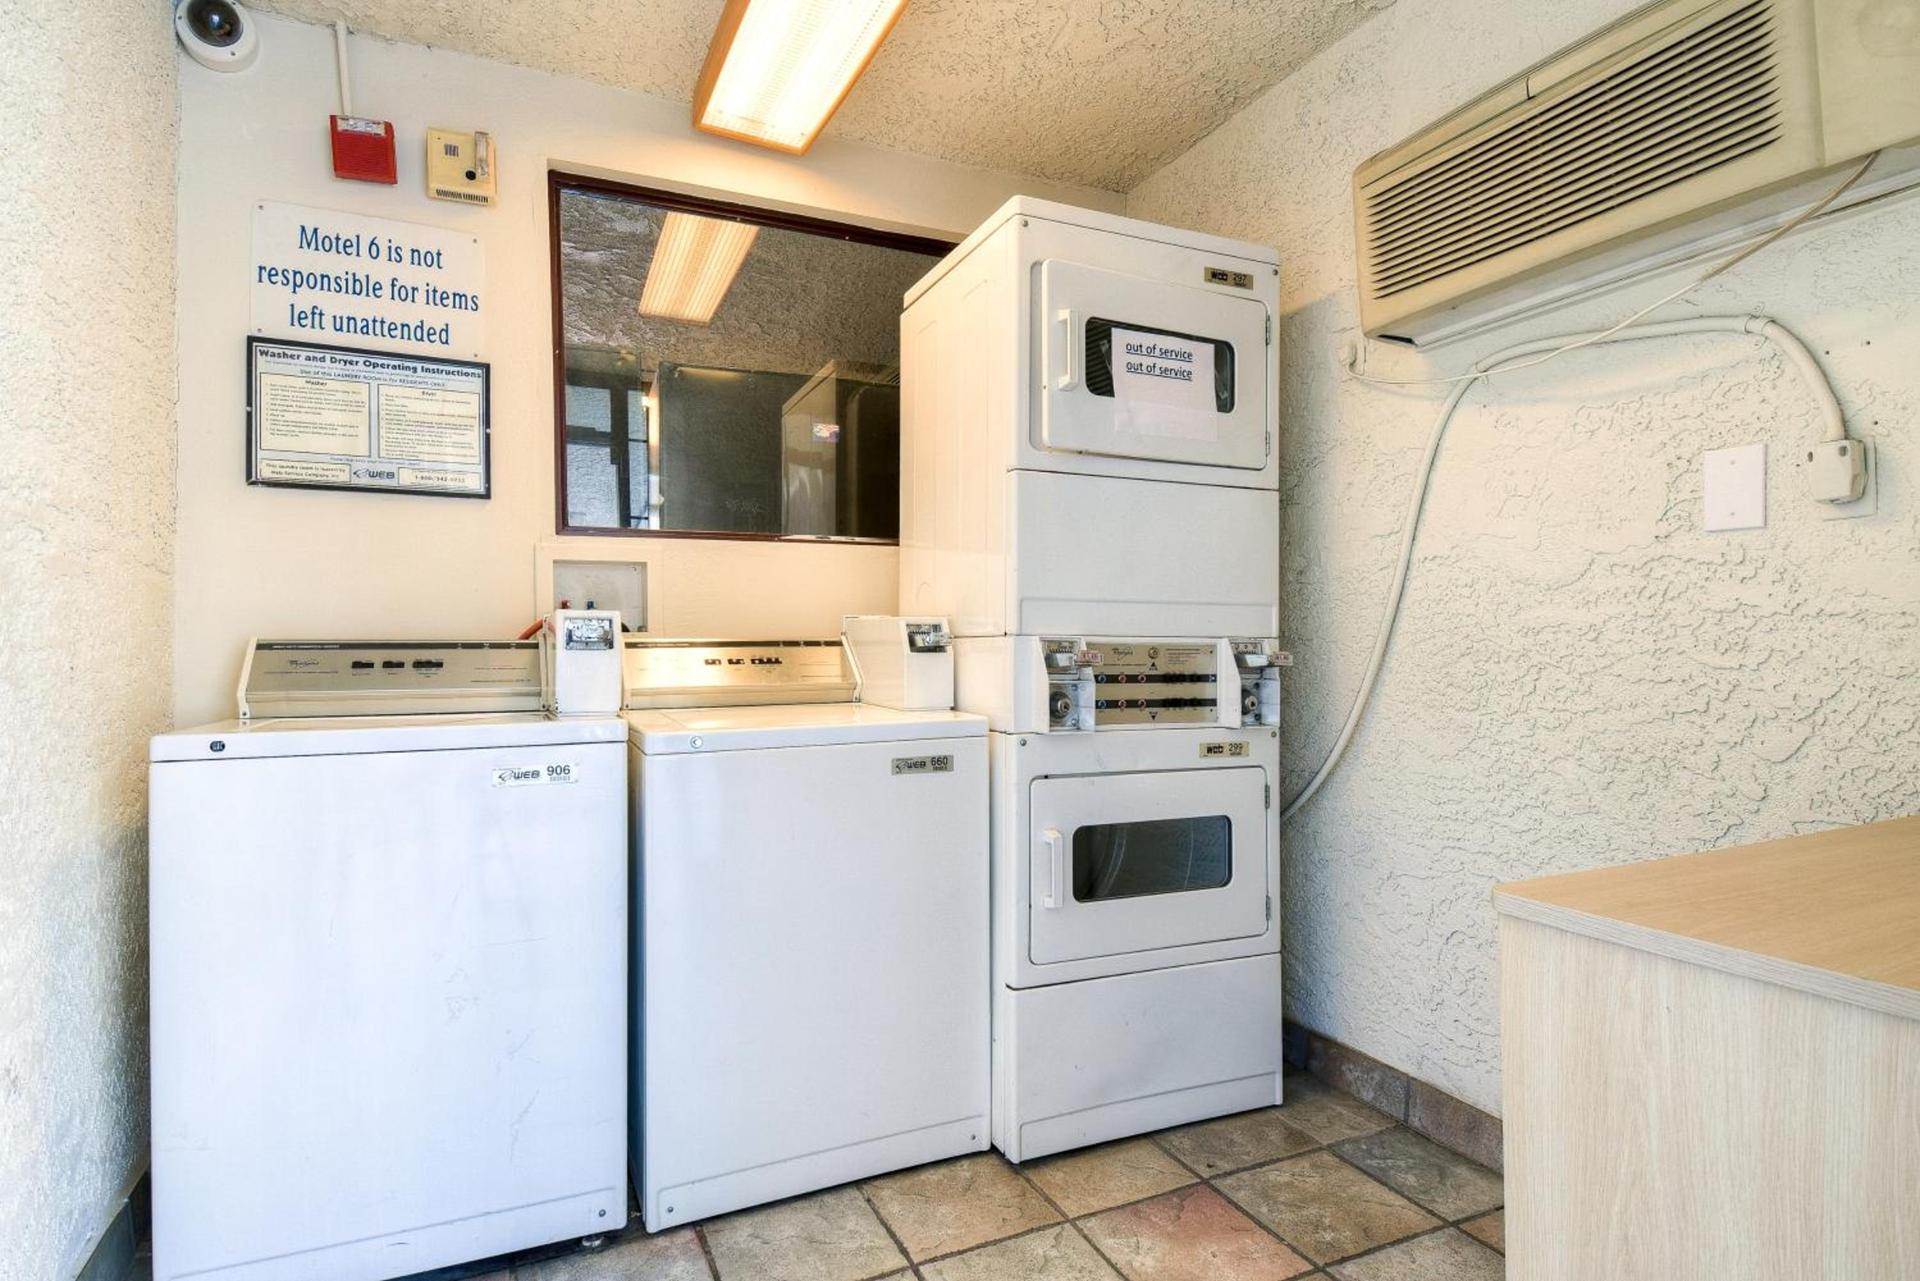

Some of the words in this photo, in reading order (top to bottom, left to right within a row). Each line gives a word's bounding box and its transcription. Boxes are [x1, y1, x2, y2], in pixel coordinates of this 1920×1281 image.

[298, 224, 361, 258] Motel
[368, 236, 380, 260] 6
[387, 239, 402, 264] is
[410, 247, 443, 269] not
[257, 264, 383, 299] responsible
[390, 276, 419, 304] for
[425, 282, 479, 312] items
[289, 303, 325, 330] left
[332, 314, 450, 345] unattended
[1125, 342, 1143, 353] out
[1145, 343, 1157, 355] of
[1159, 347, 1193, 360] service
[258, 348, 302, 360] Washer
[304, 354, 327, 363] and
[330, 356, 360, 367] Dryer
[363, 360, 418, 374] Operating
[421, 365, 482, 379] Instructions
[1126, 361, 1144, 372] out
[1145, 362, 1157, 373] of
[1159, 366, 1193, 379] service
[368, 470, 395, 480] WEB
[930, 756, 948, 766] 660
[513, 769, 541, 779] WEB
[546, 764, 571, 776] 906
